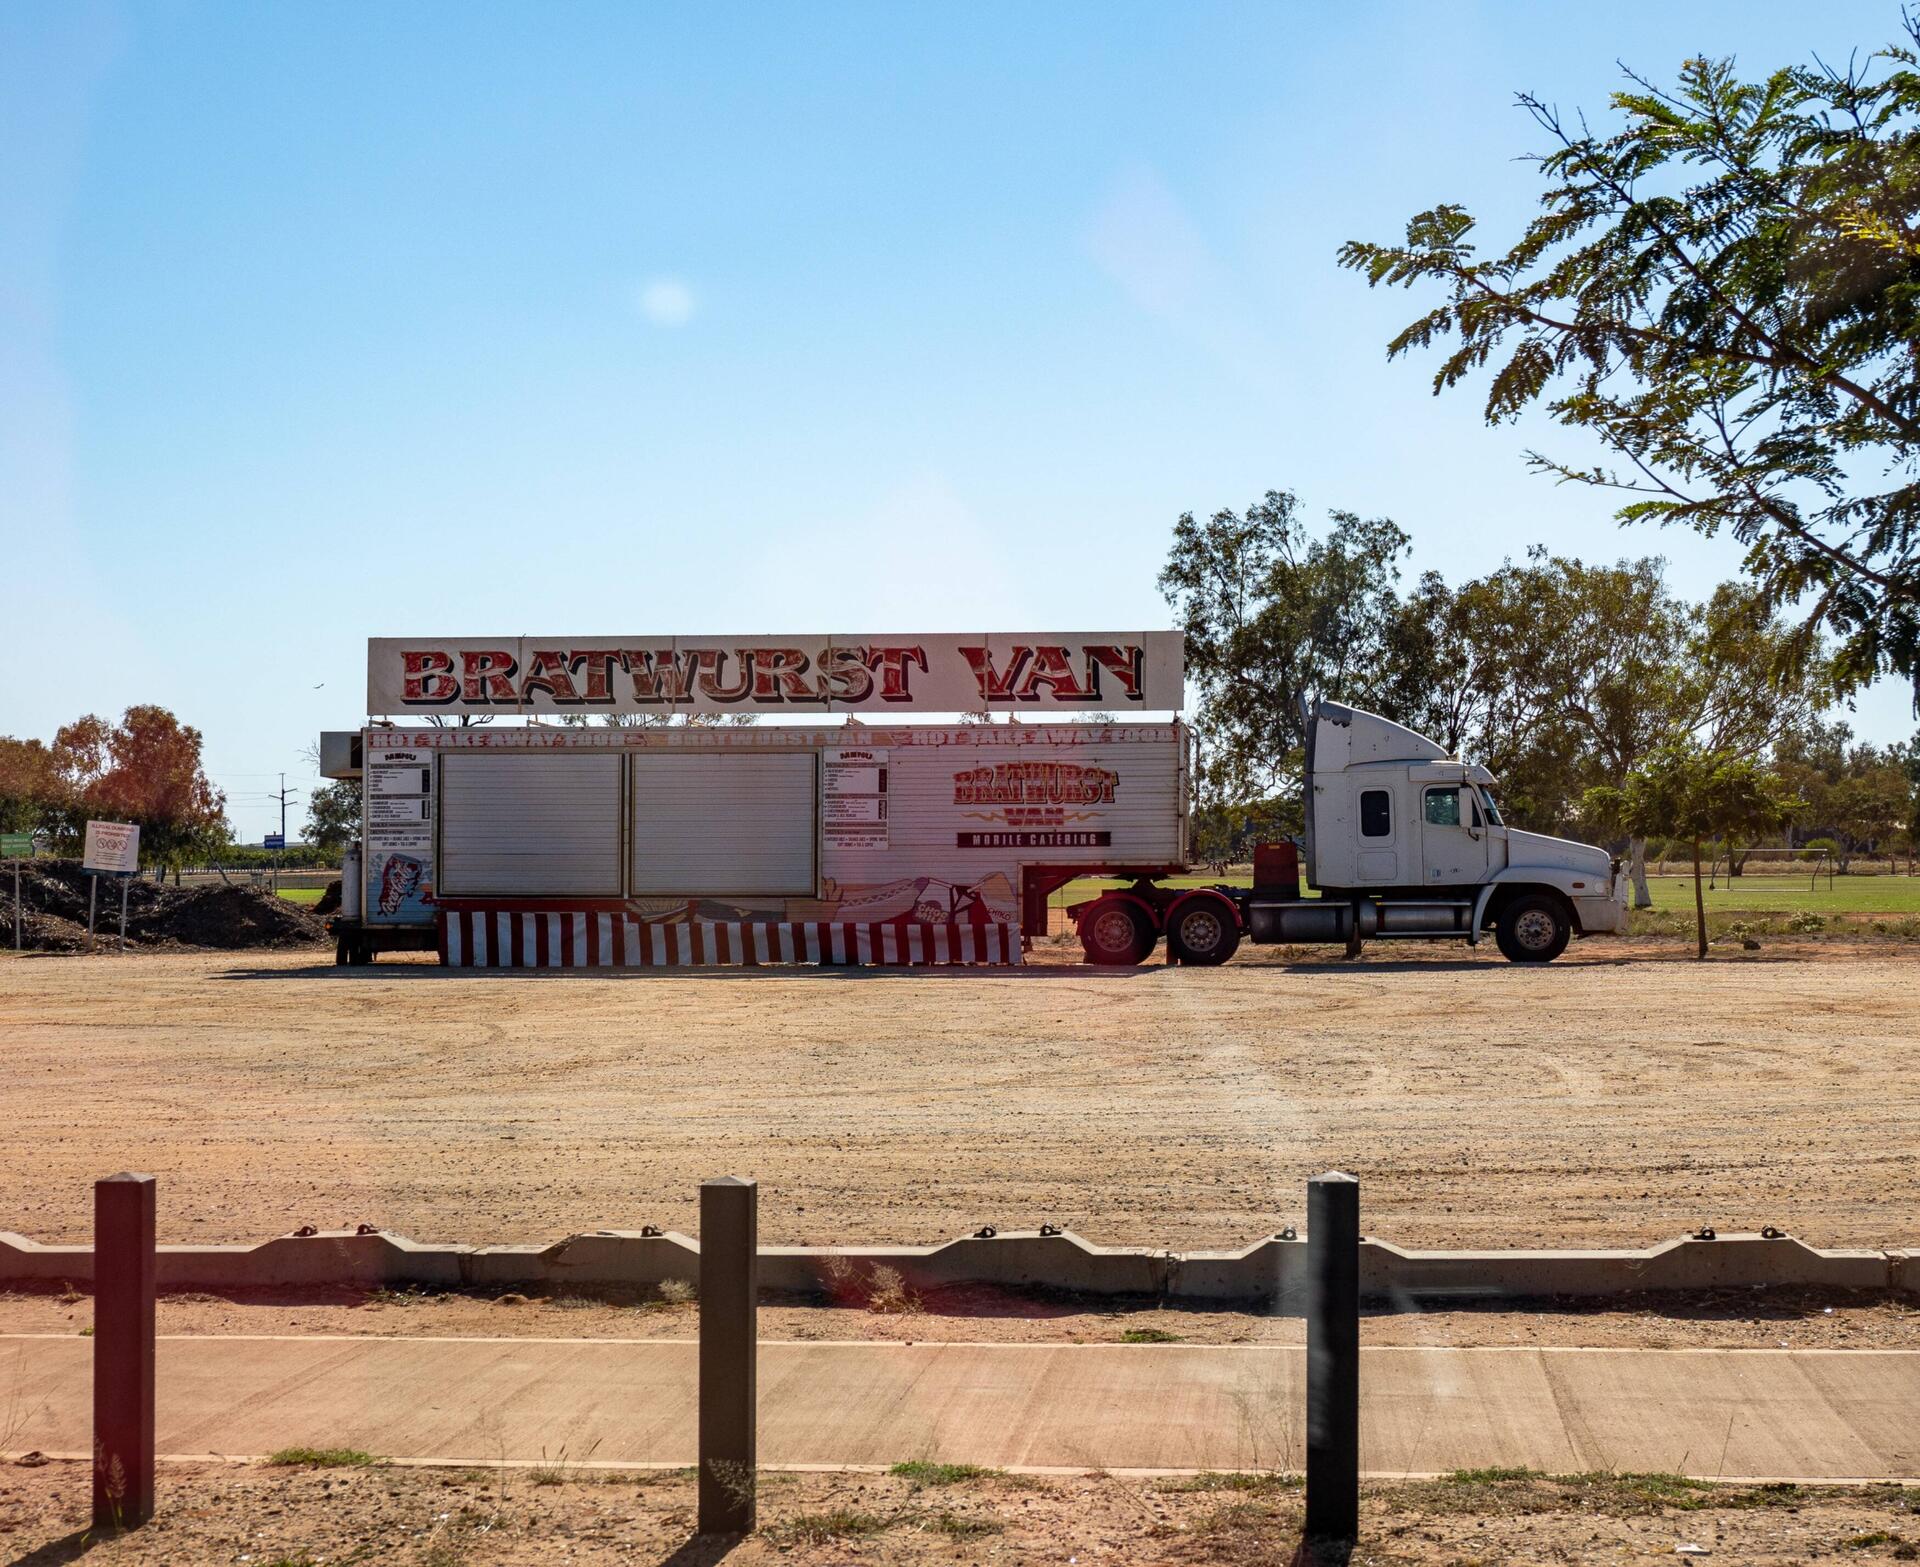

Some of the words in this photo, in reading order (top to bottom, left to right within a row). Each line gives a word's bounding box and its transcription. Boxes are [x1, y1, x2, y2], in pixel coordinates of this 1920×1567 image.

[400, 645, 929, 704] BRATWURST
[957, 645, 1144, 702] VAN
[953, 761, 1120, 805] BRATWURST
[1003, 807, 1064, 827] VAN
[972, 834, 1021, 846] MOBILE
[1029, 833, 1096, 846] CATERING
